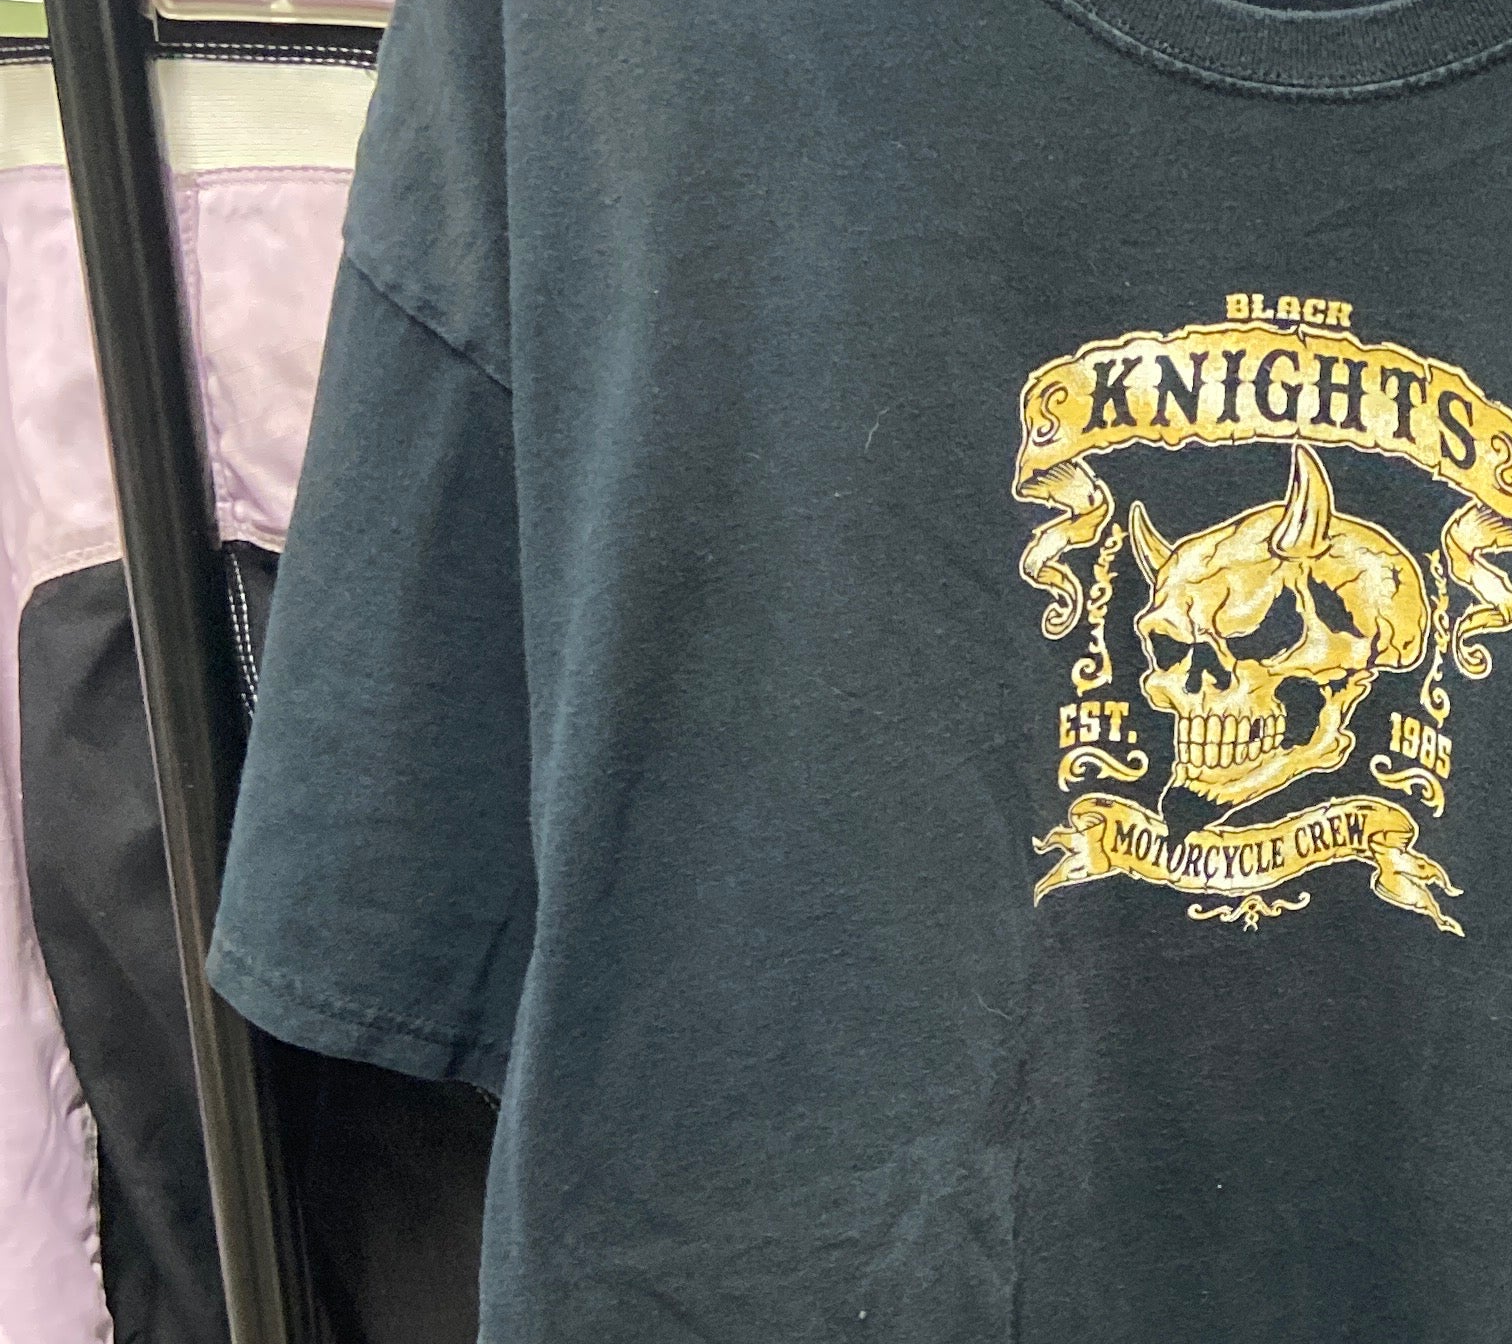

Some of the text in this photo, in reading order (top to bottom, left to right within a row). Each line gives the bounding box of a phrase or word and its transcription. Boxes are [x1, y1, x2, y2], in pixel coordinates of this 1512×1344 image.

[1226, 293, 1353, 327] BLACK
[1082, 348, 1476, 471] KNIGHTS
[1059, 700, 1137, 749] EST.
[1389, 711, 1452, 780] 1985
[1111, 812, 1369, 881] MOTORCYCLE CREW
